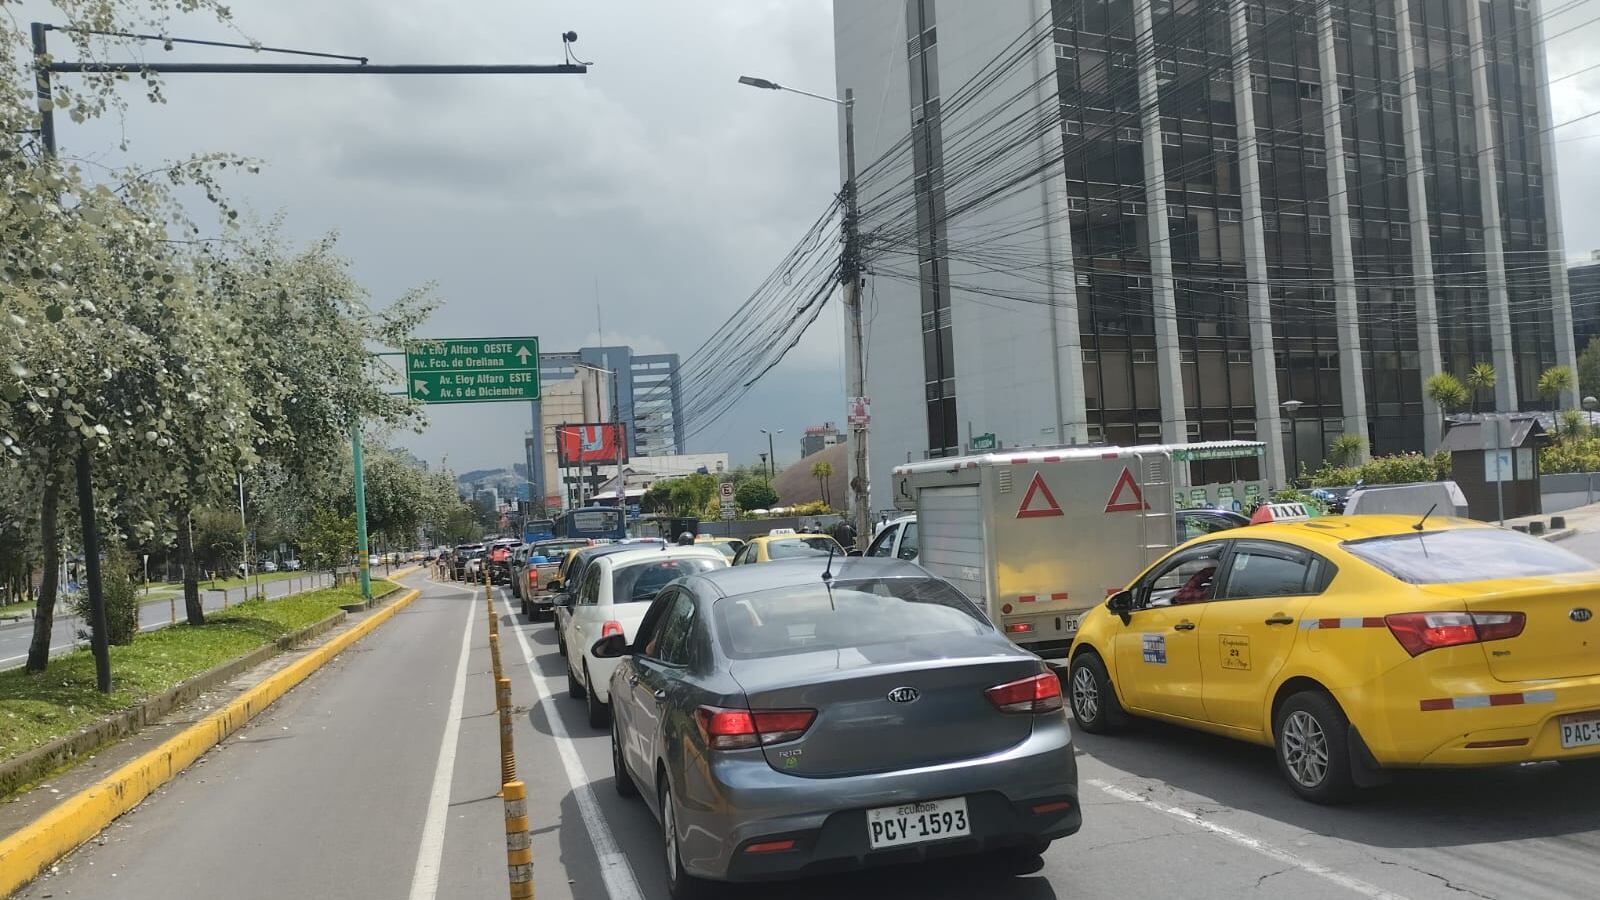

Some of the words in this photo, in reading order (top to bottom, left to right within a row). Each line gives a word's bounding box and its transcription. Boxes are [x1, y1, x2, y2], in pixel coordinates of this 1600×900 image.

[429, 345, 448, 357] Eloy
[451, 344, 478, 354] Alfaro
[484, 343, 513, 353] OESTE
[413, 359, 427, 368] Av.
[429, 358, 449, 368] Fco.
[452, 357, 463, 367] de
[466, 357, 504, 367] Orellana
[440, 375, 452, 385] Av.
[455, 374, 474, 386] Eloy
[477, 373, 504, 384] Alfaro
[509, 372, 532, 383] ESTE
[440, 388, 453, 398] Av.
[456, 387, 462, 397] 6
[465, 387, 476, 397] de
[479, 386, 524, 396] Diciembre
[1269, 505, 1308, 517] TAXI
[891, 689, 918, 704] KIA
[898, 803, 936, 816] ECUADOR
[871, 810, 967, 843] PCY-1593
